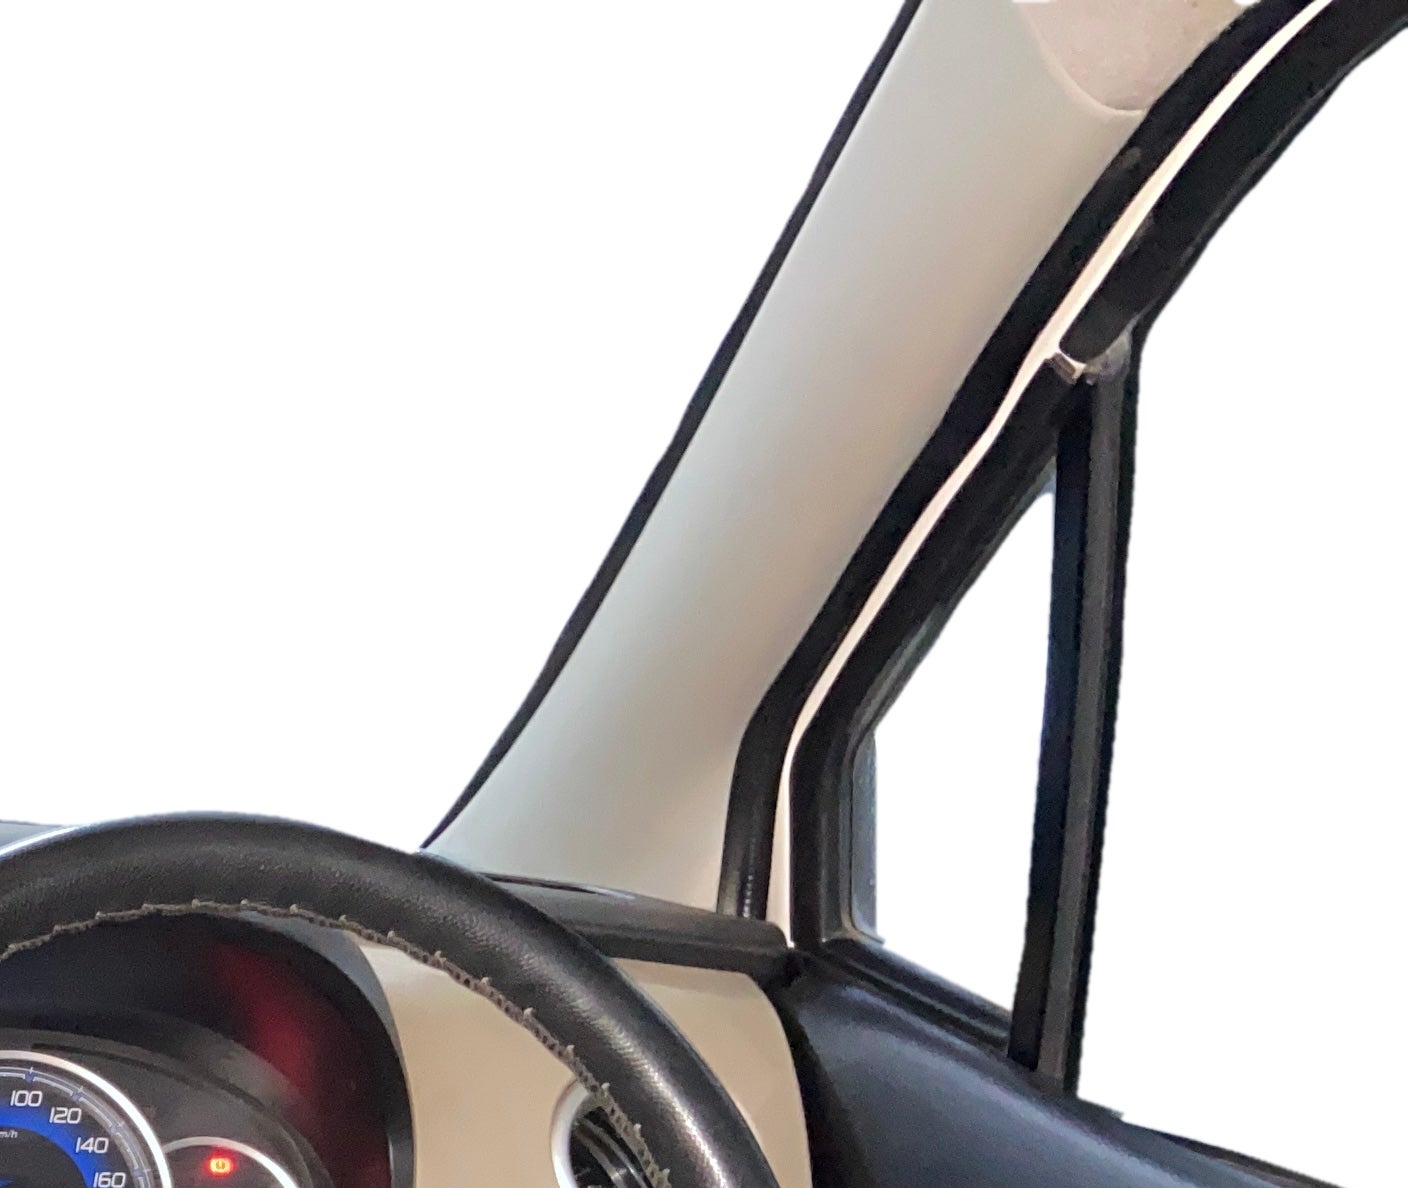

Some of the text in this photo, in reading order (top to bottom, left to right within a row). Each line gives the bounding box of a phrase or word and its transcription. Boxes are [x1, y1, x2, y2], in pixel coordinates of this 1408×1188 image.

[10, 1089, 43, 1107] 100
[49, 1106, 82, 1124] 120
[75, 1136, 110, 1154] 140
[93, 1171, 127, 1188] 160
